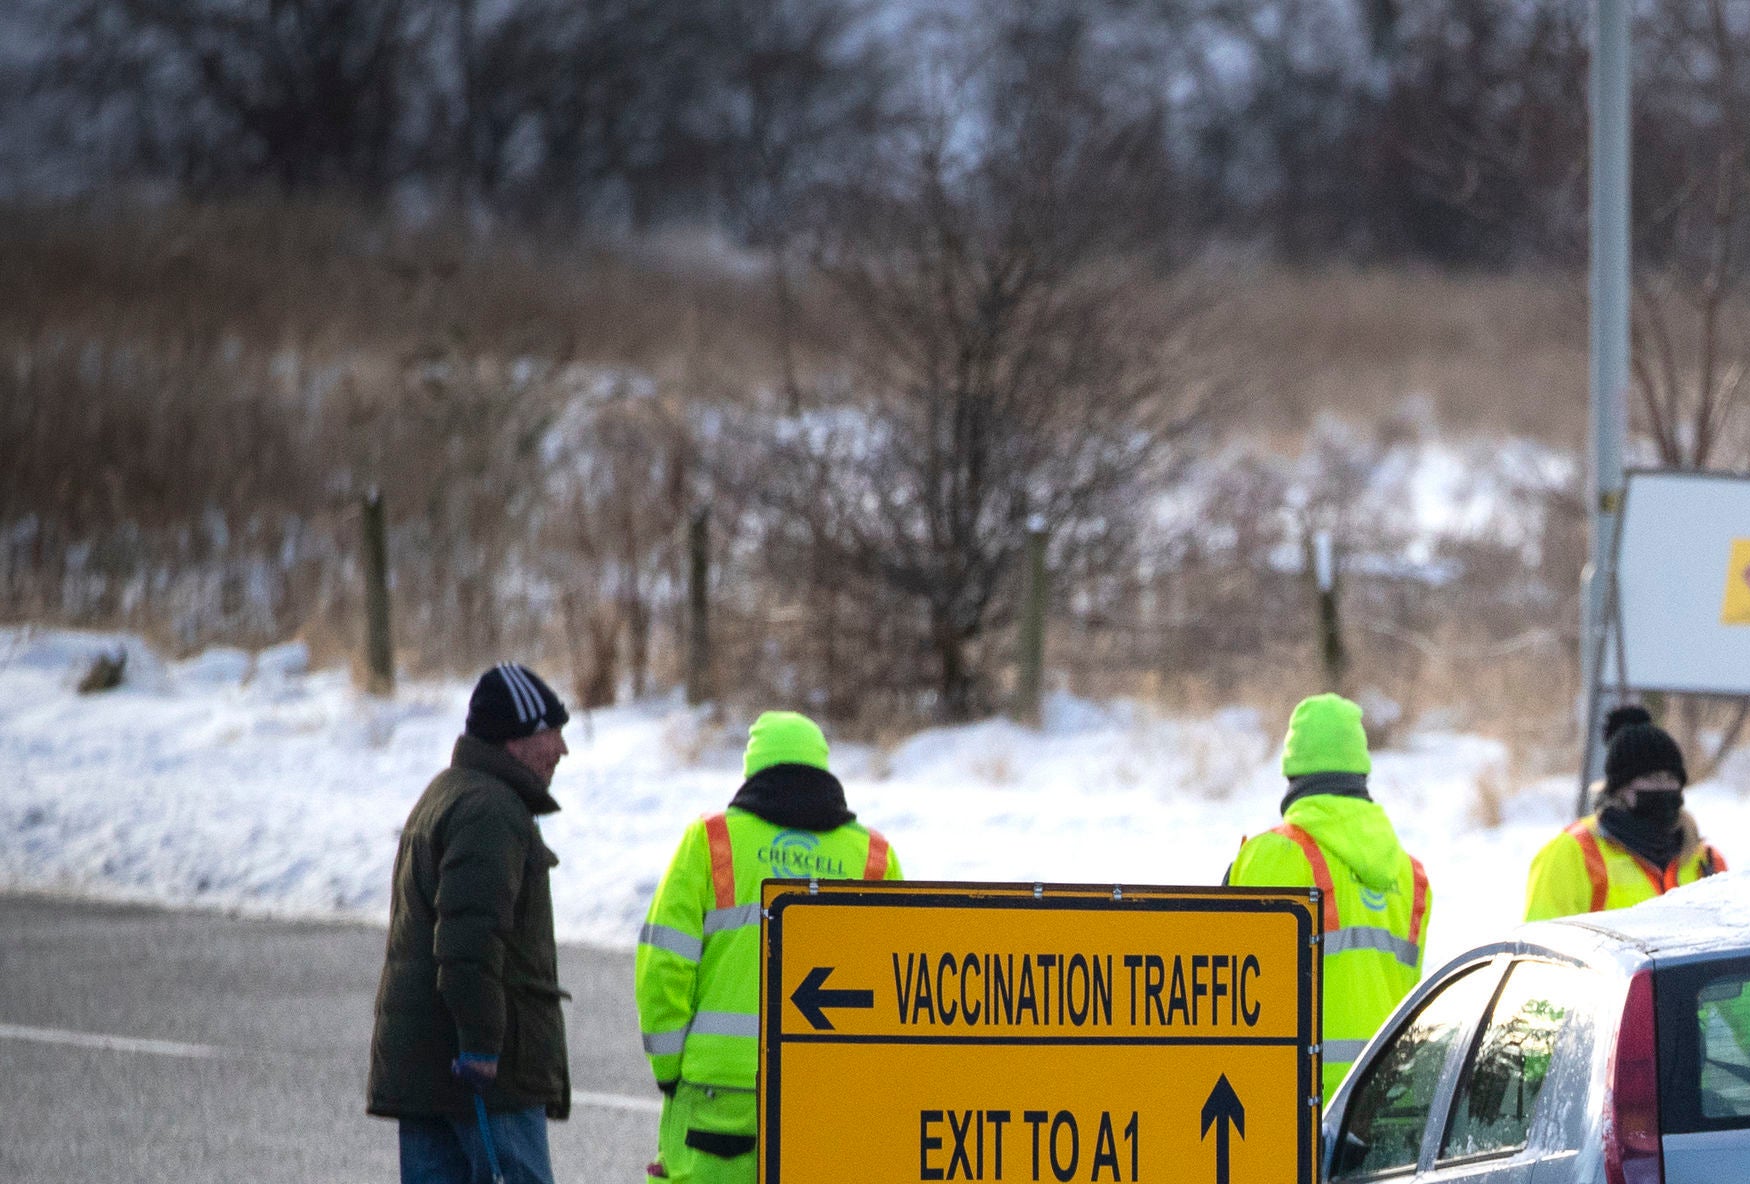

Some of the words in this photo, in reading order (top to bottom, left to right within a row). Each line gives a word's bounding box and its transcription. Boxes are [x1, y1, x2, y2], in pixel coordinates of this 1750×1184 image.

[757, 846, 847, 878] CREXCELL
[892, 952, 1113, 1026] VACCINATION
[1123, 954, 1261, 1027] TRAFFIC
[920, 1109, 1011, 1181] EXIT
[1023, 1109, 1080, 1183] TO
[1091, 1110, 1139, 1183] A1
